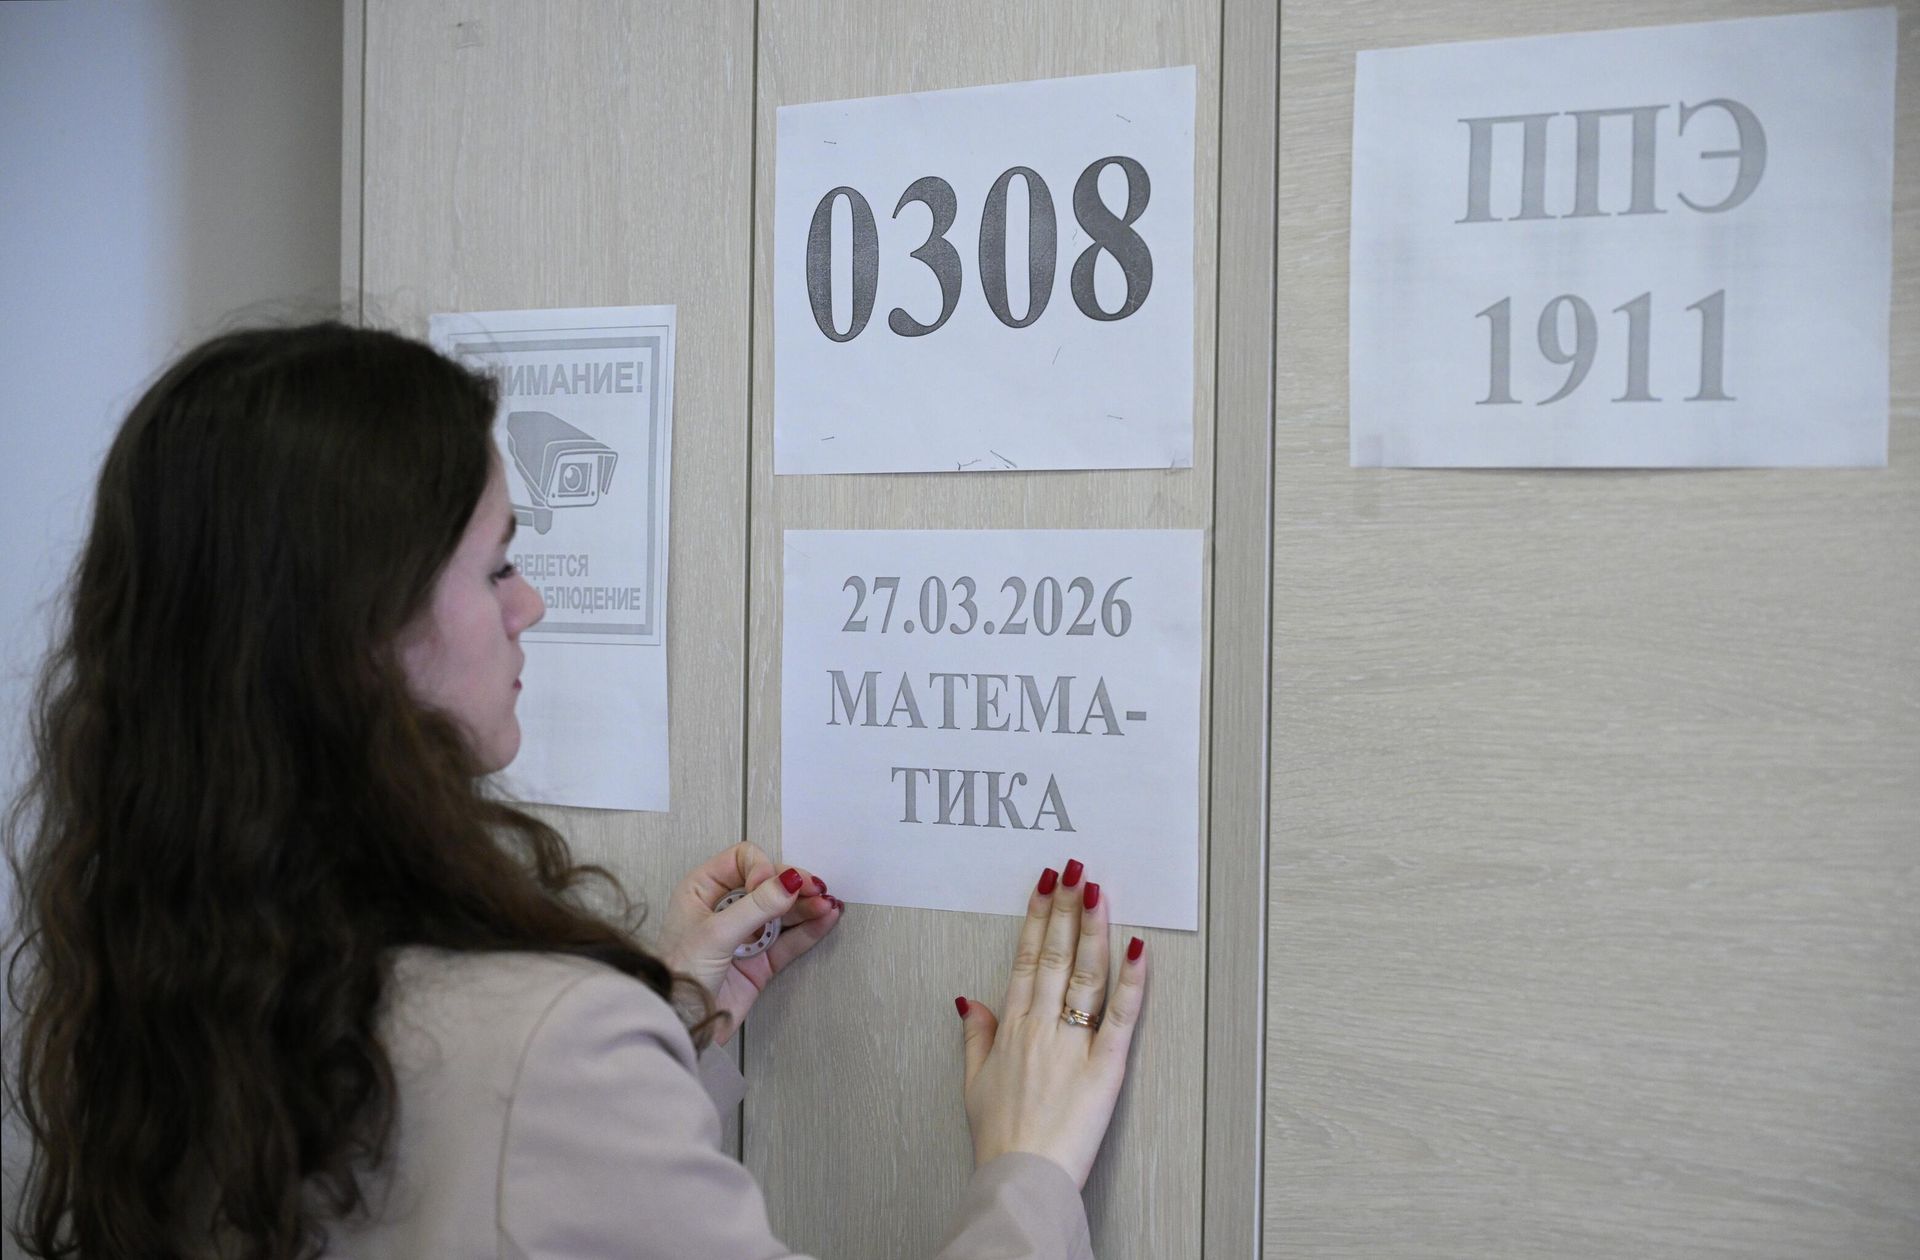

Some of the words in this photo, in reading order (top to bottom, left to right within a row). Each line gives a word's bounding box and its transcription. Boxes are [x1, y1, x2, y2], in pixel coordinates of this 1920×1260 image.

[1454, 97, 1768, 224] ППЭ
[806, 155, 1154, 343] 0308
[487, 361, 644, 397] ИМАНИЕ!
[1474, 288, 1738, 407] 1911
[513, 553, 589, 581] ВЕДЕТСЯ
[534, 585, 641, 614] БЛЮДЕНИЕ
[841, 575, 1133, 638] 27.03.2026
[826, 669, 1147, 737] МАТЕМА-
[890, 766, 1077, 832] ТИКА
